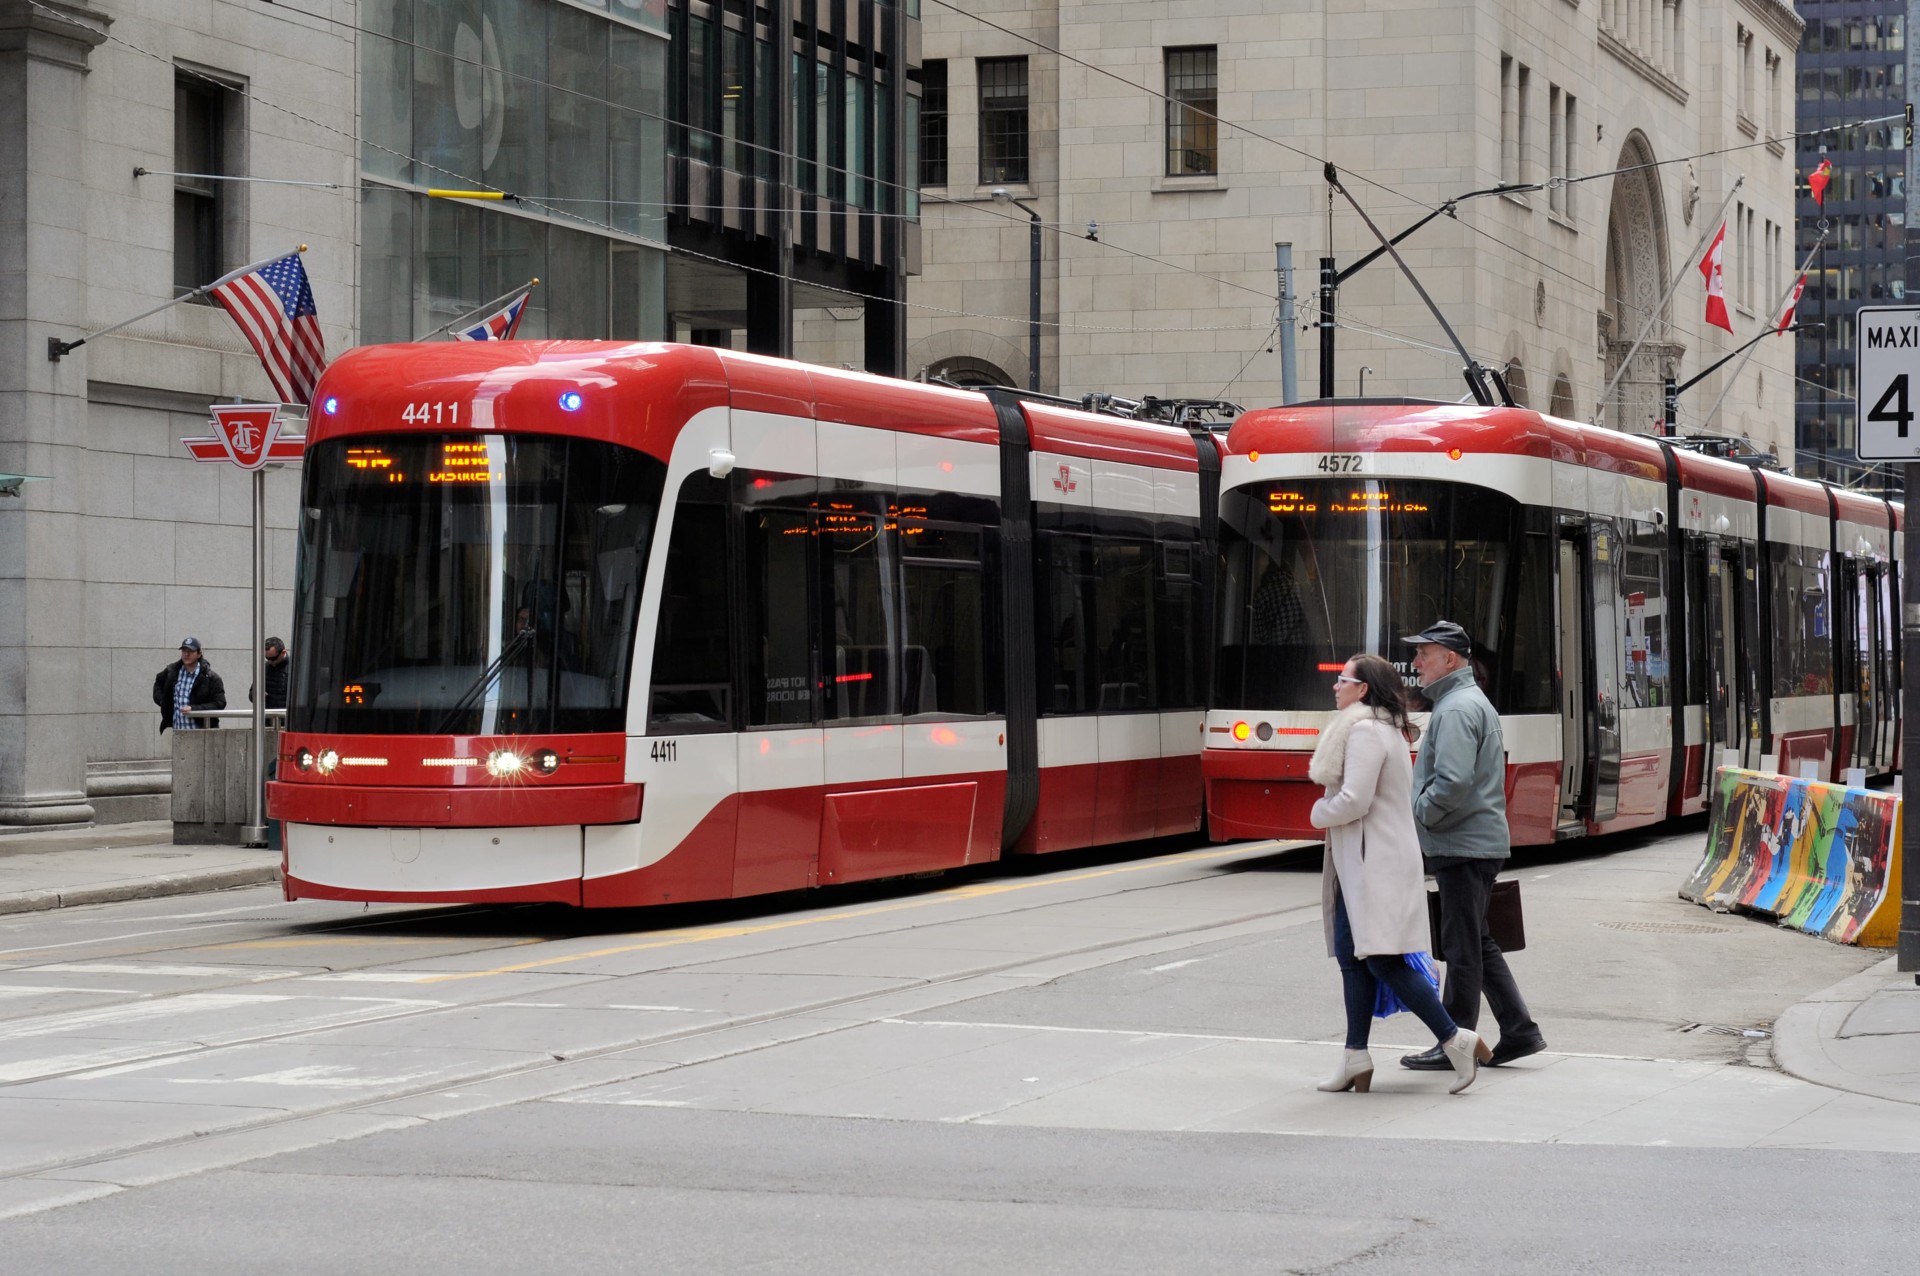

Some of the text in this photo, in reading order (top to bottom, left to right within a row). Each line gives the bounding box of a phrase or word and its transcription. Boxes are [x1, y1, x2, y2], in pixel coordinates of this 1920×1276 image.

[401, 401, 459, 424] 4411
[1318, 455, 1364, 473] 4572
[650, 740, 677, 762] 4411
